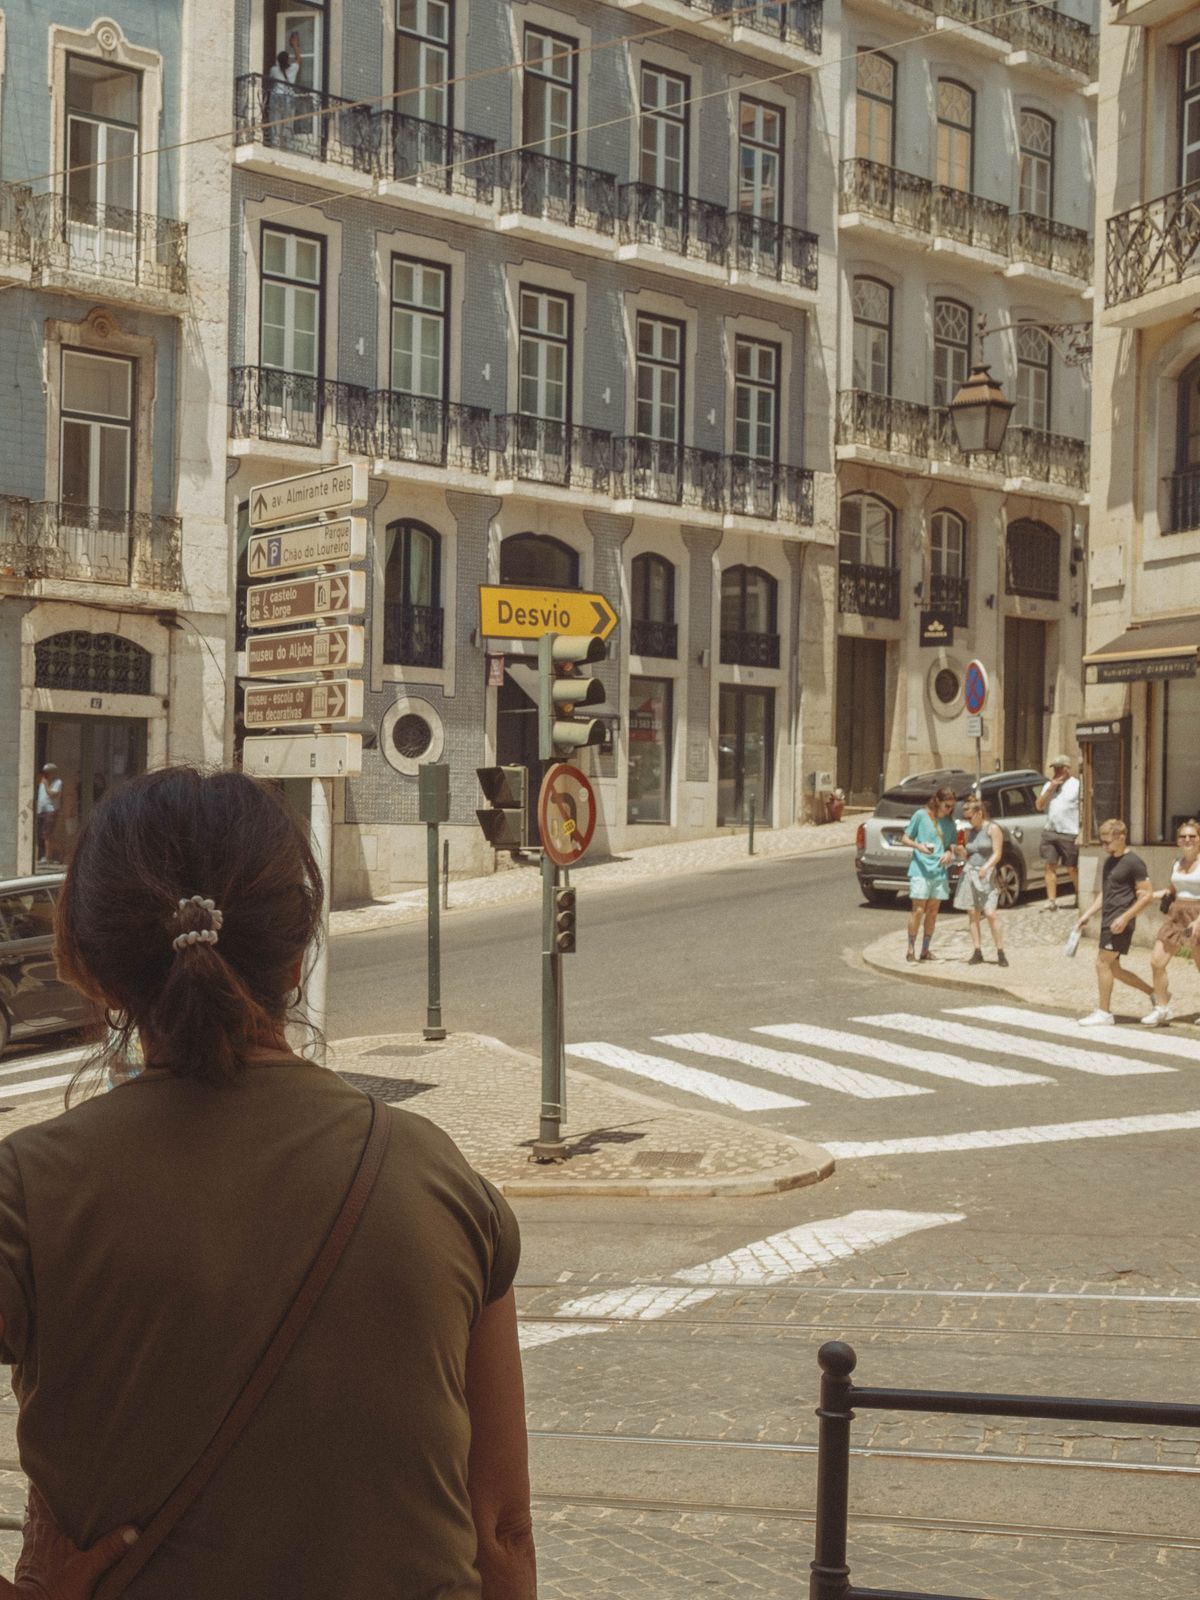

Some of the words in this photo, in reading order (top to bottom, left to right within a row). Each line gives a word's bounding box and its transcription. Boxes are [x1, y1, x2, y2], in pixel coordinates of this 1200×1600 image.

[287, 481, 328, 504] Almirante
[332, 475, 351, 493] Reis
[325, 526, 349, 542] Parque
[283, 548, 302, 562] Chão
[305, 544, 314, 558] do
[317, 541, 349, 556] Loureiro
[270, 587, 297, 603] castelo
[251, 607, 260, 620] de
[272, 604, 291, 619] Jorge
[498, 600, 570, 628] Desvio
[277, 645, 286, 660] do
[289, 642, 312, 661] Aljube
[273, 690, 293, 704] escola
[295, 690, 304, 703] de
[247, 709, 263, 721] artes
[266, 706, 302, 720] decorativas
